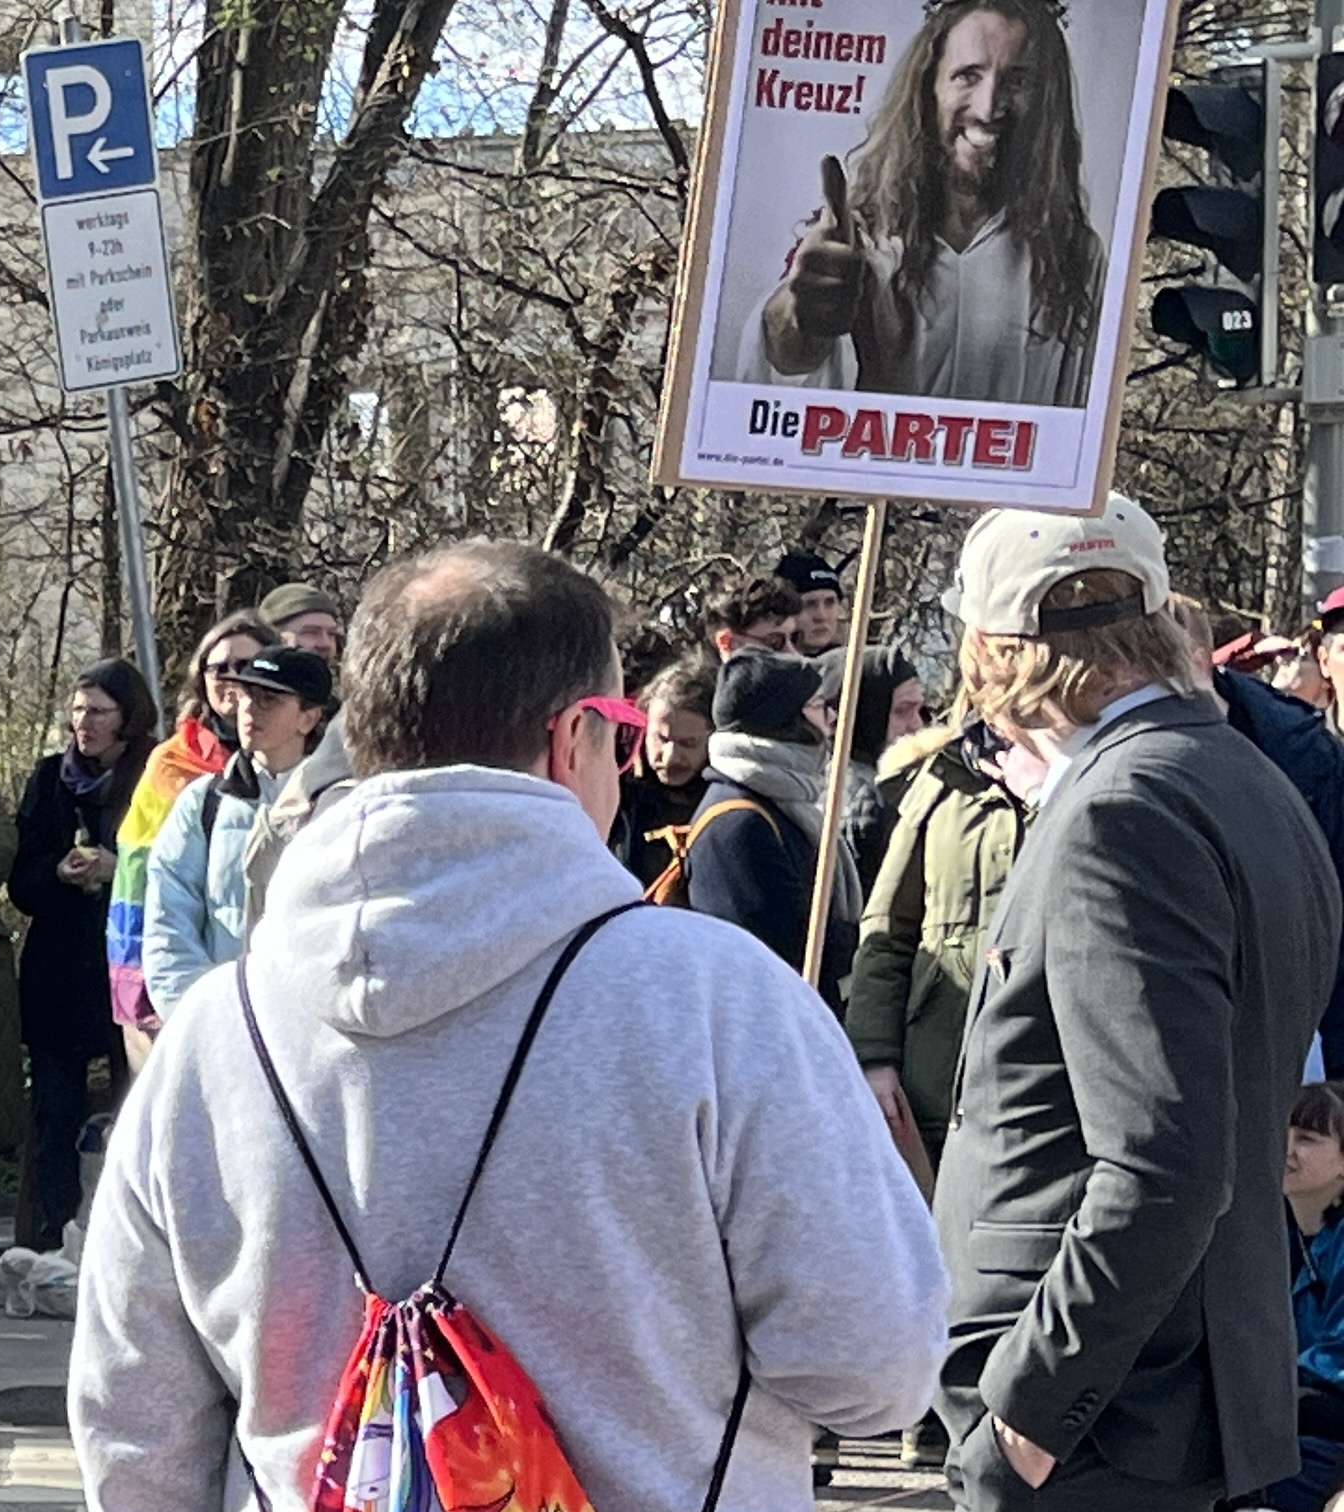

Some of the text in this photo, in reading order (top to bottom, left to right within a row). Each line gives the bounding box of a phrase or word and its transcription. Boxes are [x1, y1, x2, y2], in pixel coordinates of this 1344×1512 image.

[761, 18, 887, 63] deinem
[755, 68, 866, 114] Kreuz!
[45, 64, 112, 180] P
[76, 211, 130, 230] werktags
[66, 263, 153, 289] mit Parkschein
[100, 297, 125, 314] oder
[80, 320, 152, 345] Parkausweis
[1222, 310, 1252, 330] 023
[86, 350, 153, 373] Königsplatz
[749, 399, 1039, 471] Die PARTEI
